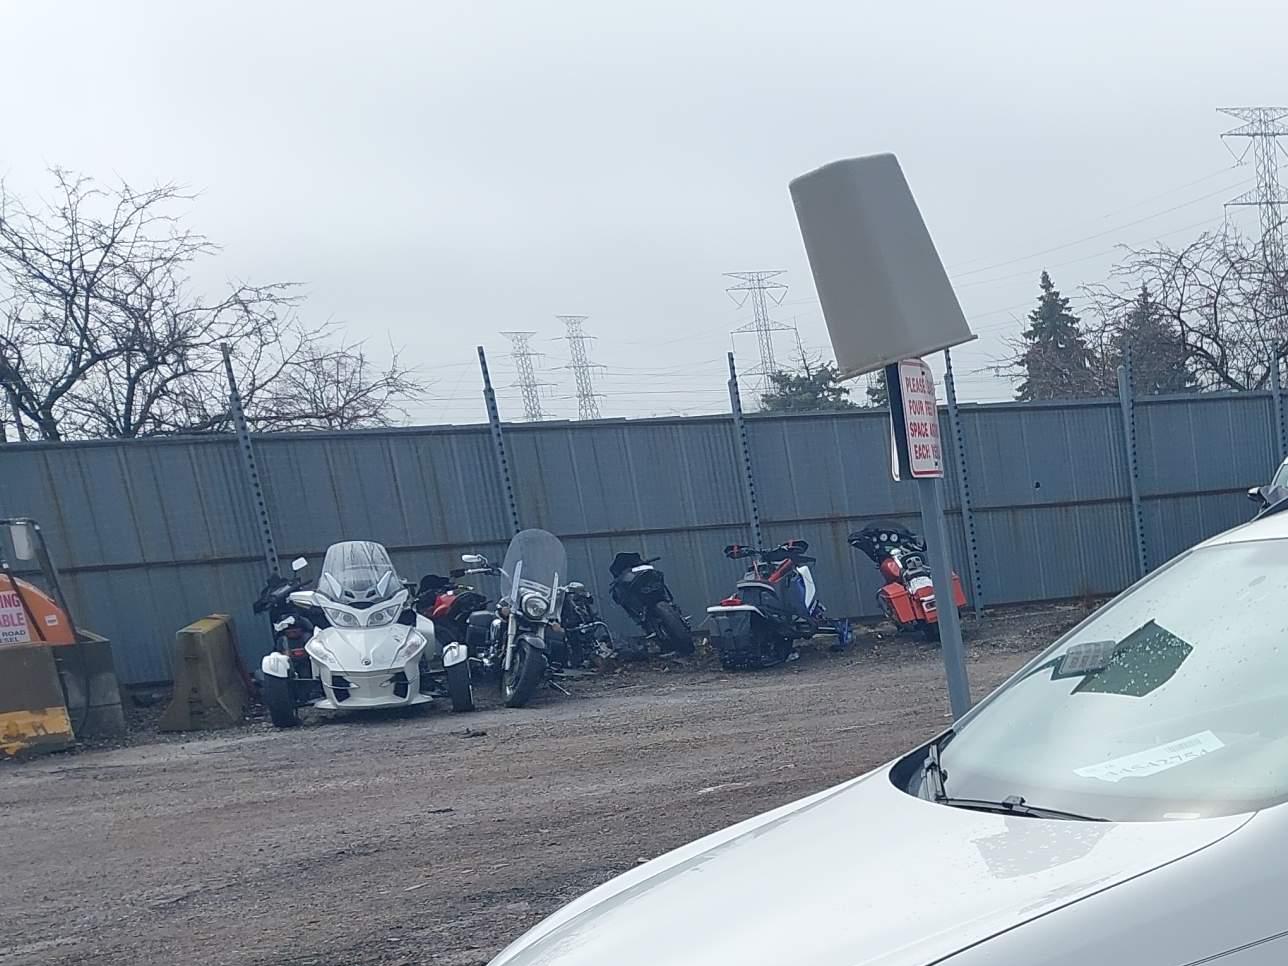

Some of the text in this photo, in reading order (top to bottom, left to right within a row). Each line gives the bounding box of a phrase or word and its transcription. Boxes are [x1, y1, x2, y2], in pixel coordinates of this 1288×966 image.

[904, 376, 927, 393] PLEASE
[909, 400, 925, 416] FOUR
[909, 421, 929, 437] SPACE
